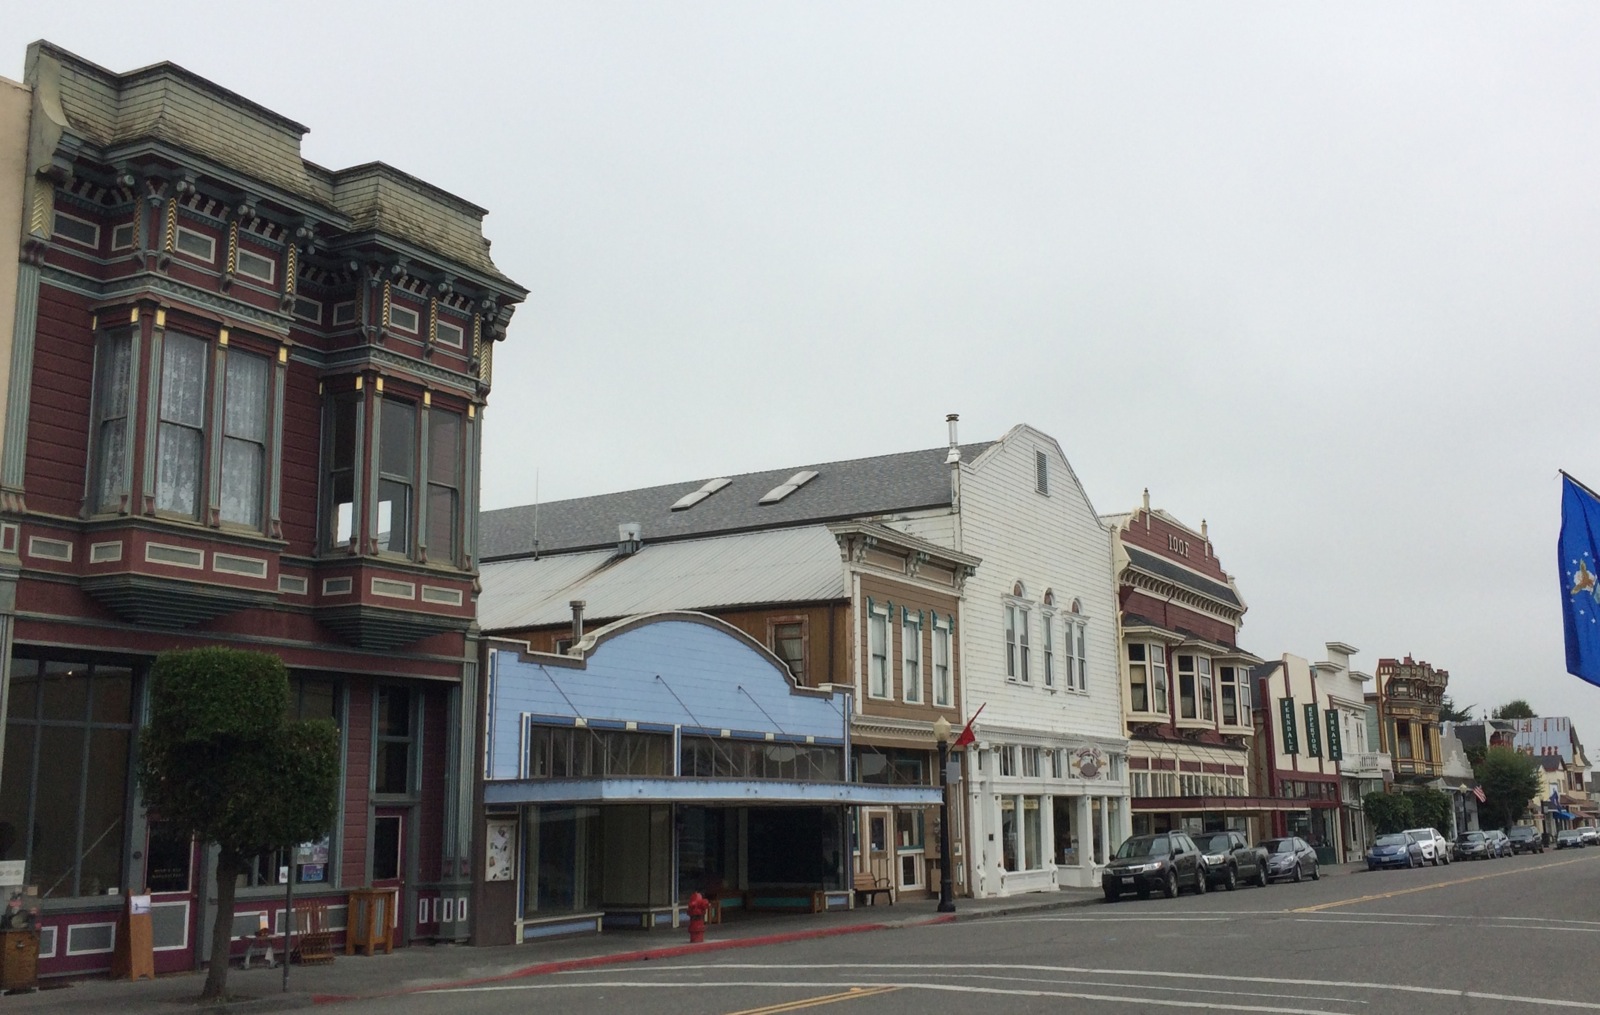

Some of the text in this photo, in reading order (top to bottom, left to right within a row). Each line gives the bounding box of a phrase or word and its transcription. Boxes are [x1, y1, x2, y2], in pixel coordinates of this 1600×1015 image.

[1284, 700, 1294, 751] FERNDALE
[1308, 706, 1318, 754] REPERTORY
[1329, 712, 1338, 758] THEATRE
